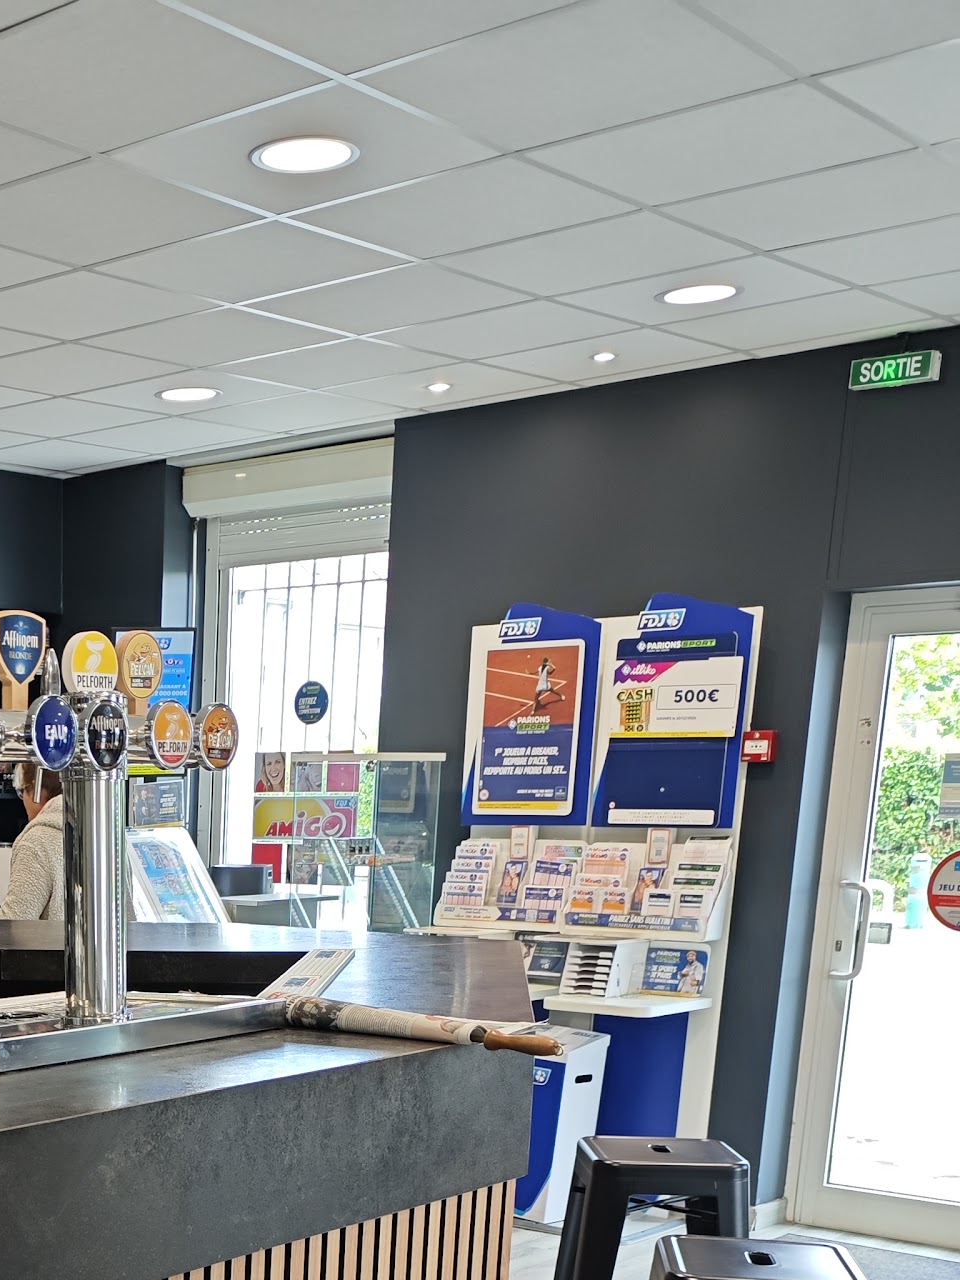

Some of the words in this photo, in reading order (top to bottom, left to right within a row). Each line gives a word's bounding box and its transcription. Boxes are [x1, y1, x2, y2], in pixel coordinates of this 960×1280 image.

[859, 355, 922, 383] SORTIE
[640, 614, 665, 628] FDJ
[501, 622, 524, 636] FDJ
[2, 630, 39, 650] Affligem
[647, 640, 681, 650] PARIONS
[9, 651, 32, 660] BLONDE
[77, 674, 113, 689] PELFORTH
[616, 688, 654, 700] CASH
[674, 689, 719, 703] 500€
[517, 716, 550, 724] PARIONS
[44, 724, 68, 740] EAU
[502, 747, 525, 756] JOUEUR
[265, 809, 345, 838] AMIGO
[938, 884, 955, 892] JEU
